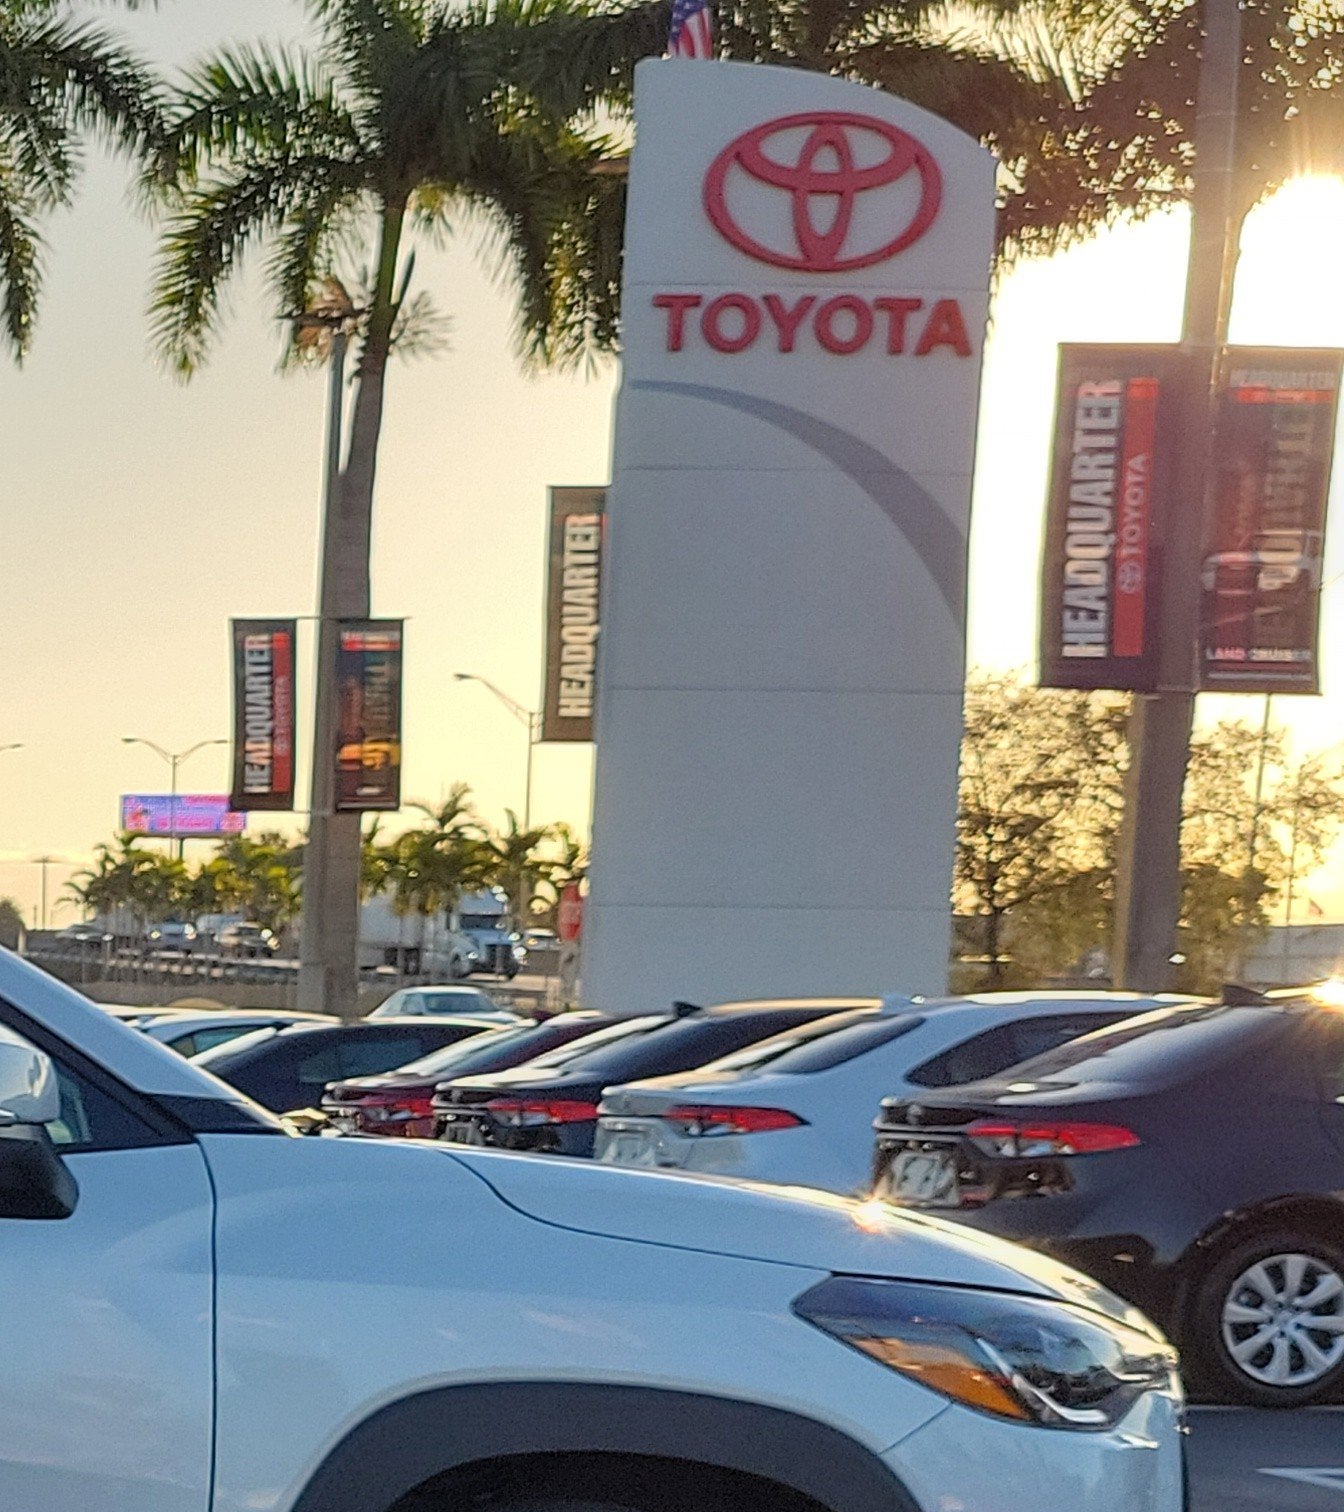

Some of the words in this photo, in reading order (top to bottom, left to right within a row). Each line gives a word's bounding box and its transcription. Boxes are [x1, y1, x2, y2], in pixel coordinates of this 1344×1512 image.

[652, 294, 972, 356] TOYOTA
[1061, 379, 1124, 659] HEADQUARTER
[1117, 453, 1149, 559] TOYOTA
[557, 513, 602, 718] HEADQUARTER
[244, 634, 273, 793] HEADQUARTER
